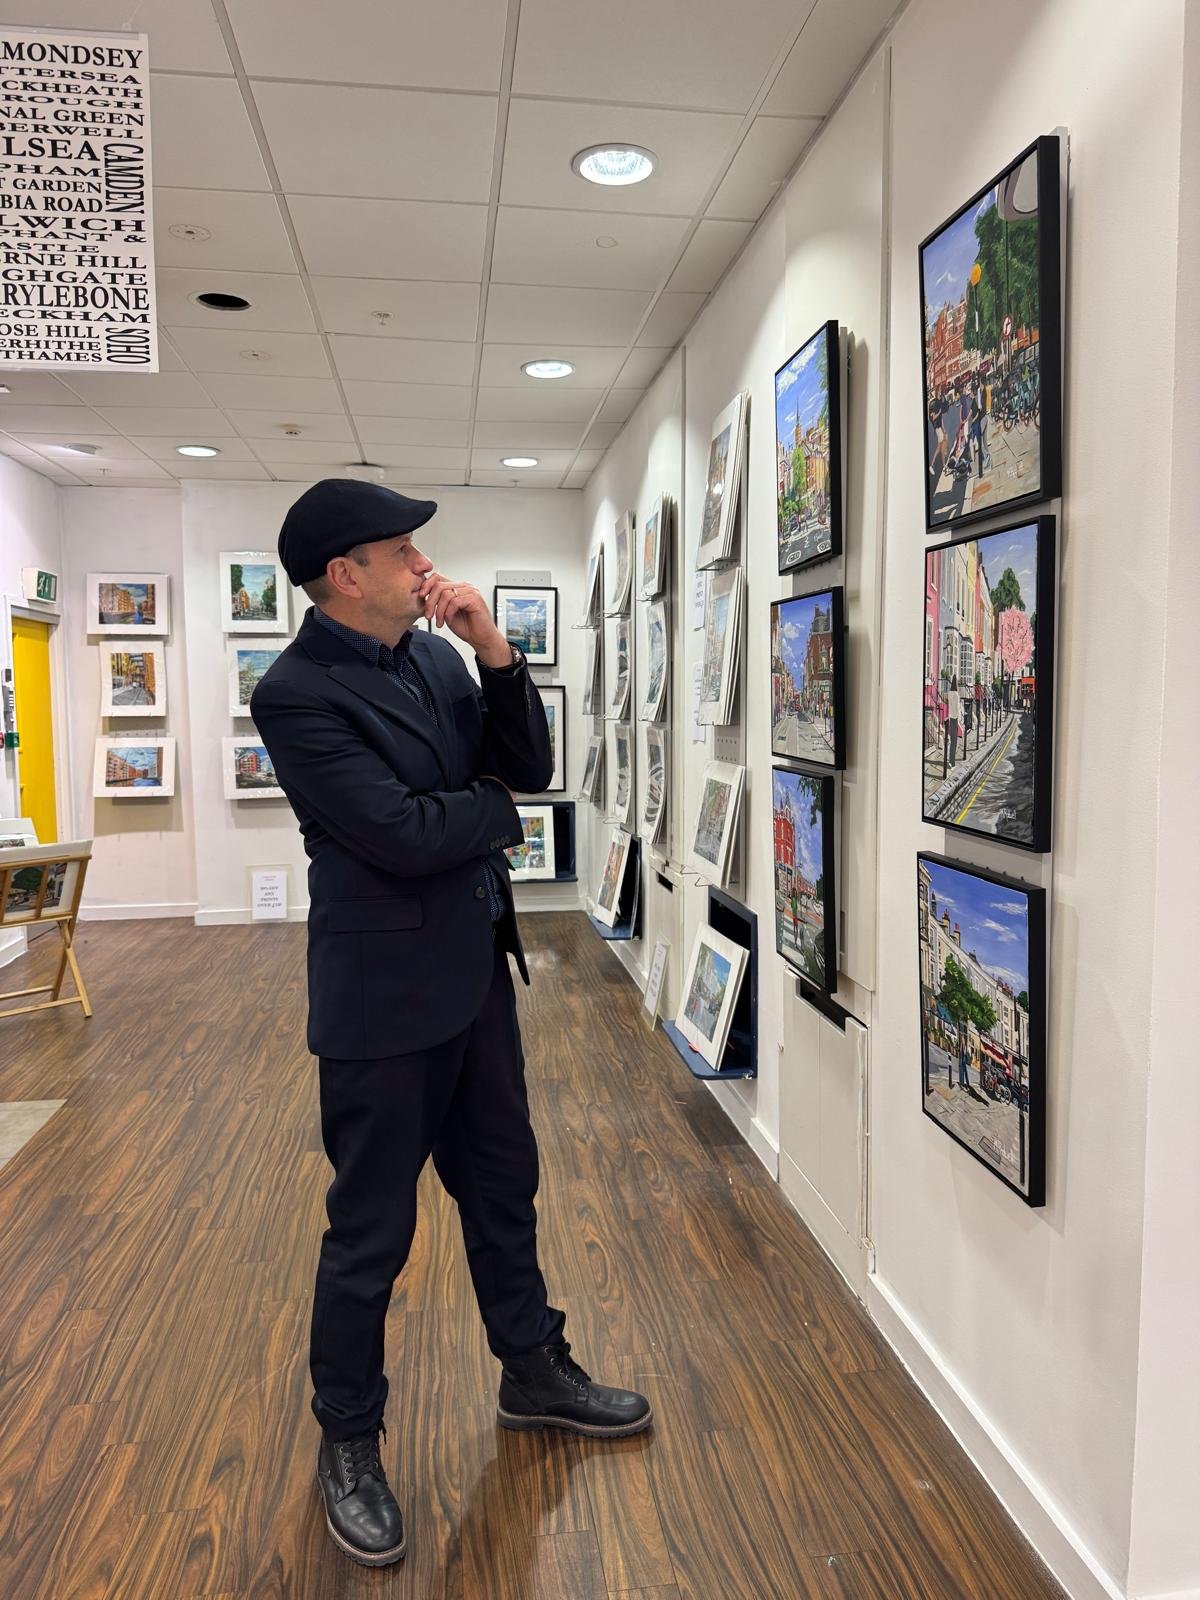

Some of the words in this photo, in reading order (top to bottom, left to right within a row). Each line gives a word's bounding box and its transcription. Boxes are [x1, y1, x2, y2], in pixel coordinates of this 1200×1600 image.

[0, 41, 143, 69] MONDSEY
[0, 80, 143, 98] CKHEATH
[2, 93, 143, 110] ROUGH
[53, 109, 145, 126] GREEN
[0, 122, 144, 139] ERWELL
[2, 136, 101, 162] LSEA
[12, 177, 102, 194] GARDEN
[103, 143, 145, 214] CAMDEN
[0, 194, 37, 210] BIA
[43, 196, 103, 213] ROAD
[0, 214, 146, 232] LWICH
[123, 234, 147, 243] &
[0, 251, 66, 267] RNE
[75, 254, 147, 269] HILL
[2, 268, 147, 286] GHGATE
[0, 283, 150, 311] RYLEBONE
[0, 323, 39, 337] OSE
[45, 324, 100, 339] HILL
[105, 327, 151, 364] SOHO
[0, 350, 102, 362] THAMES
